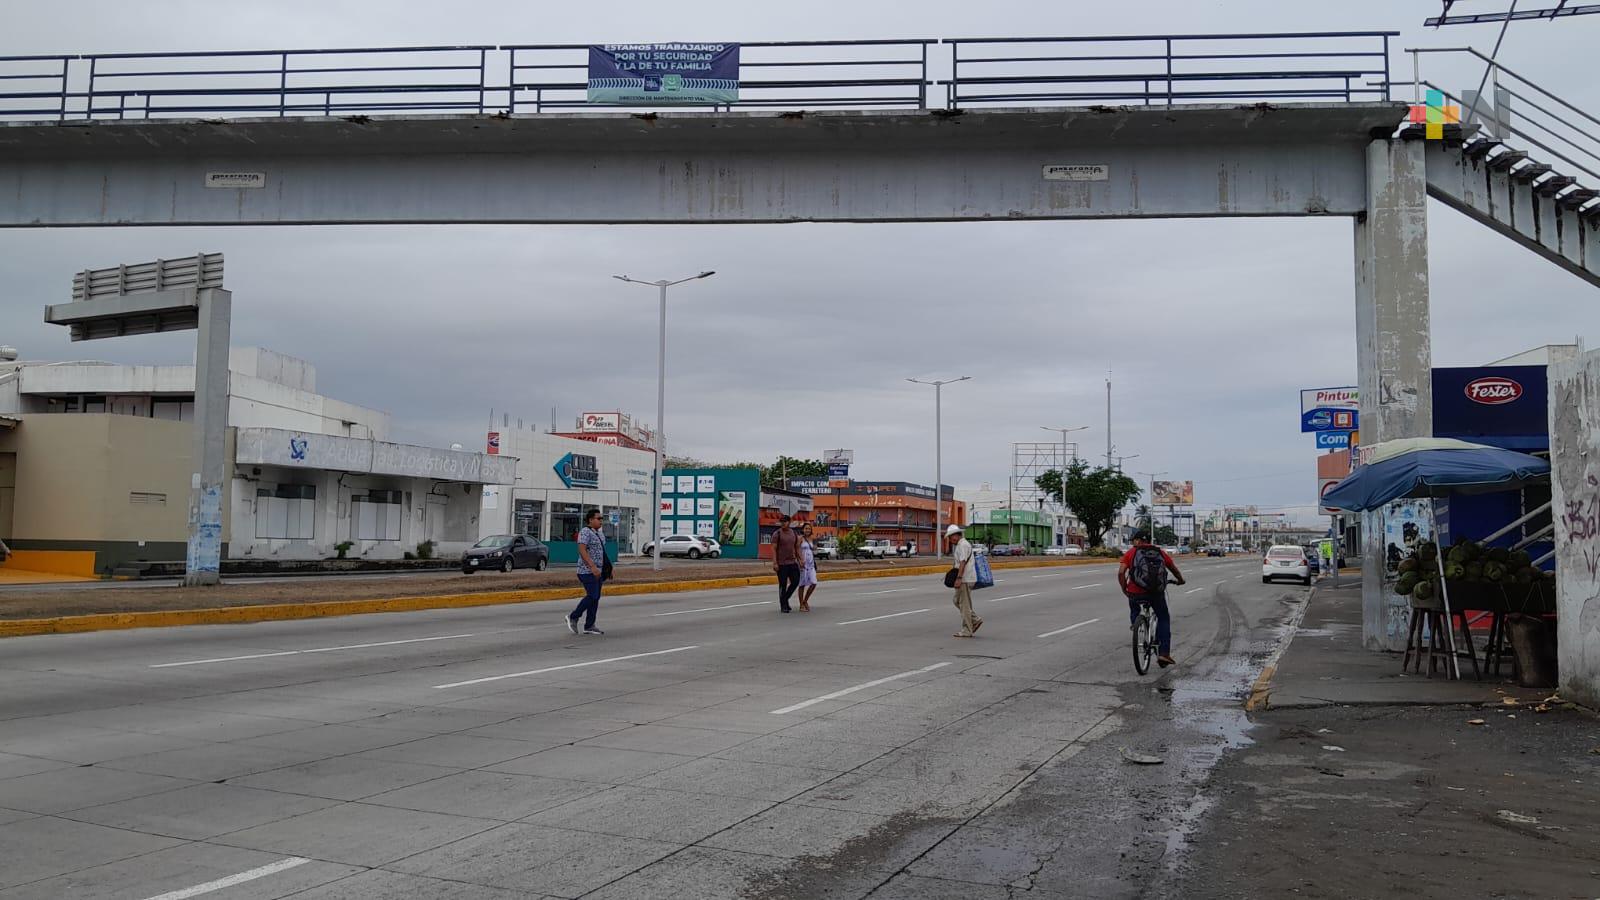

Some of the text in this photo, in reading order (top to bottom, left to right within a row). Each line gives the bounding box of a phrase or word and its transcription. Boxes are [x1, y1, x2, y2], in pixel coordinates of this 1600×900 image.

[654, 44, 724, 52] TRABAJANDO
[614, 53, 635, 61] POR
[653, 53, 713, 61] SEGURIDAD
[615, 62, 622, 70] Y
[638, 62, 653, 70] DE
[656, 62, 669, 70] TU
[670, 62, 712, 71] FAMILIA
[1471, 381, 1516, 398] Fester
